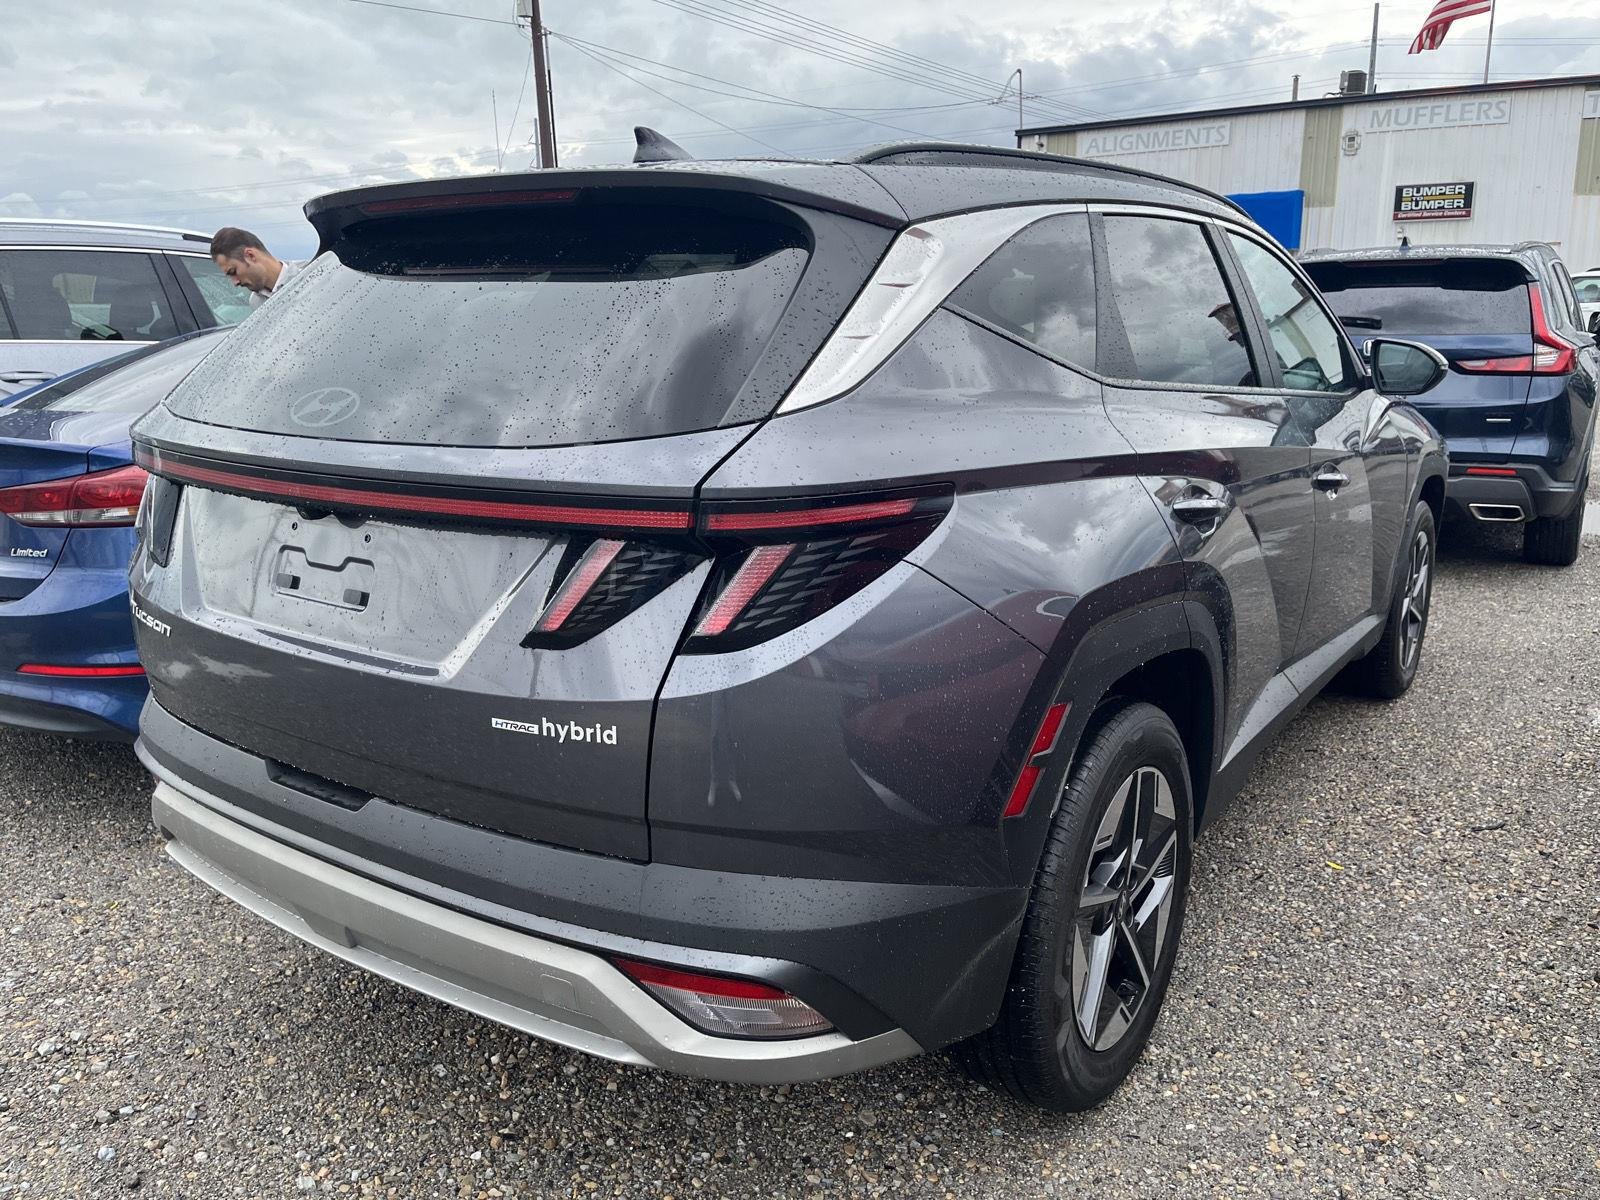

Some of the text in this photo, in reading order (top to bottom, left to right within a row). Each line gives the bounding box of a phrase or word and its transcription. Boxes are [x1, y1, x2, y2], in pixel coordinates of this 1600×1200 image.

[1370, 100, 1507, 129] MUFFLERS
[1086, 124, 1226, 154] ALIGNMENTS
[1402, 184, 1466, 197] BUMPER
[1401, 198, 1464, 211] BUMPER
[10, 548, 48, 558] Limited
[494, 716, 618, 745] HTRAC hybrid
